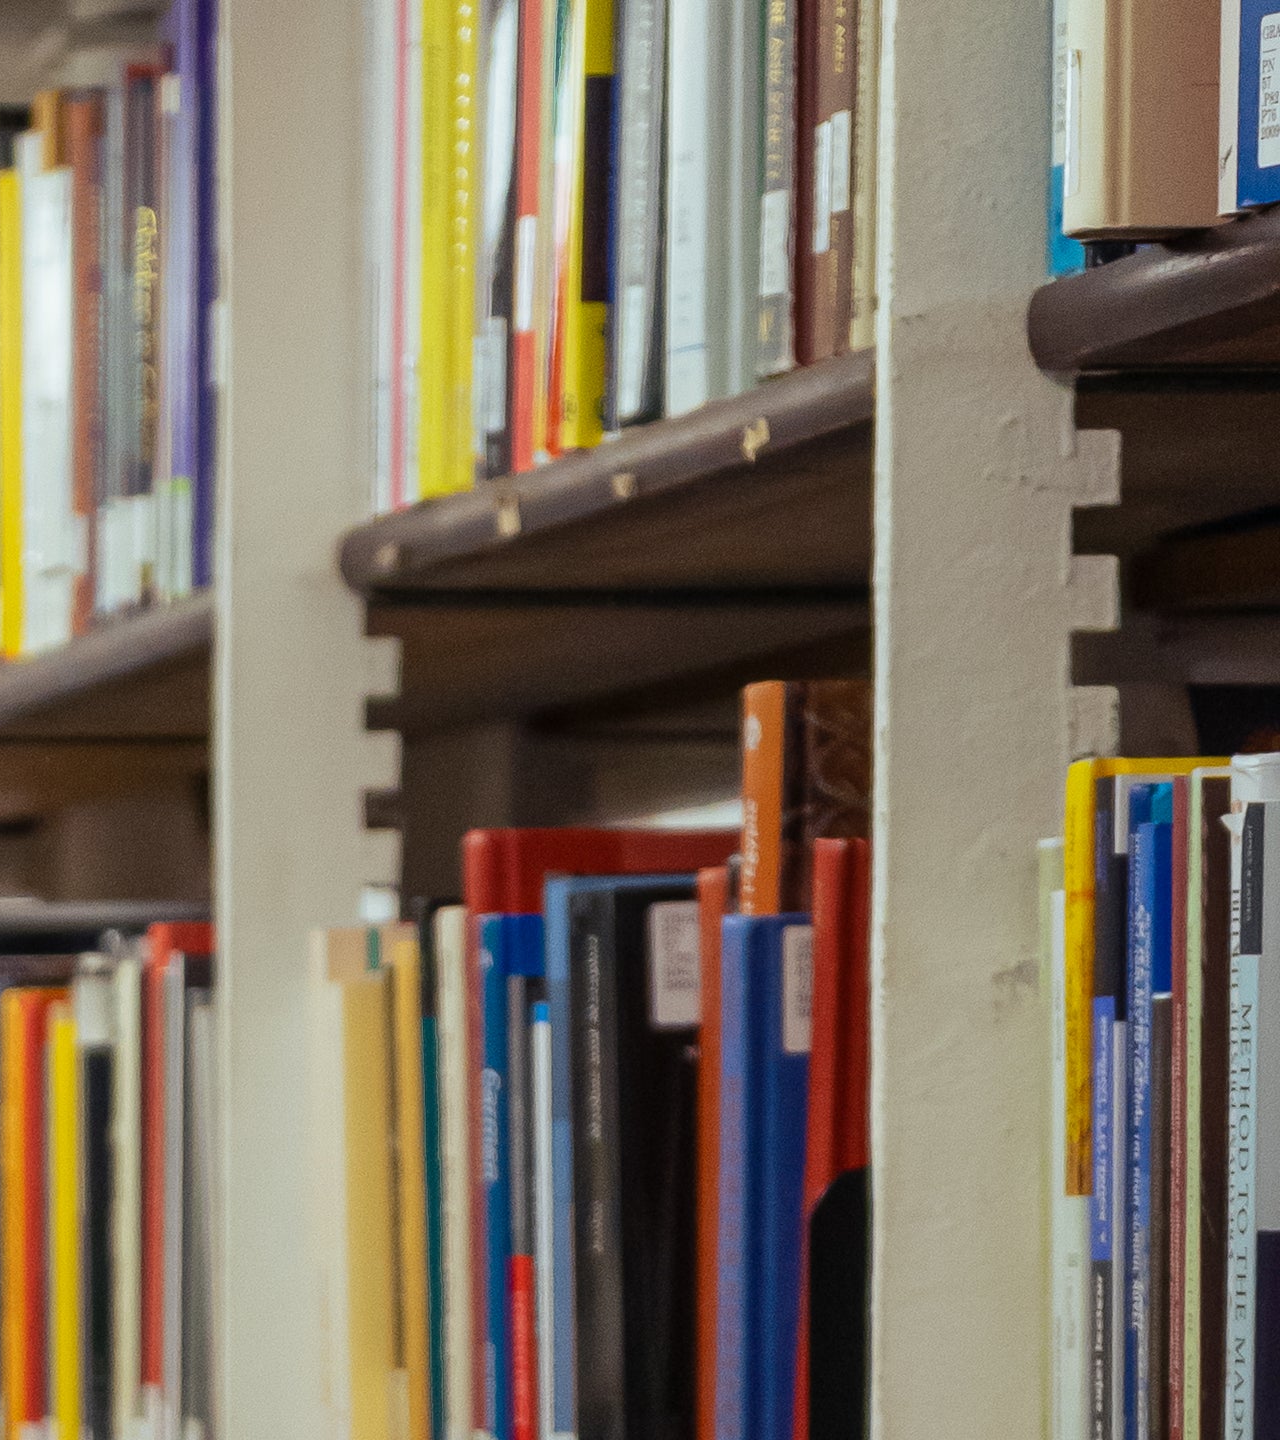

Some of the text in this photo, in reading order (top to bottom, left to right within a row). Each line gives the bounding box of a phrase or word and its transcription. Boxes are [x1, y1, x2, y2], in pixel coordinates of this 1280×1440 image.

[1238, 1003, 1253, 1171] METHOD
[1237, 1184, 1250, 1234] TO
[1235, 1246, 1248, 1320] THE
